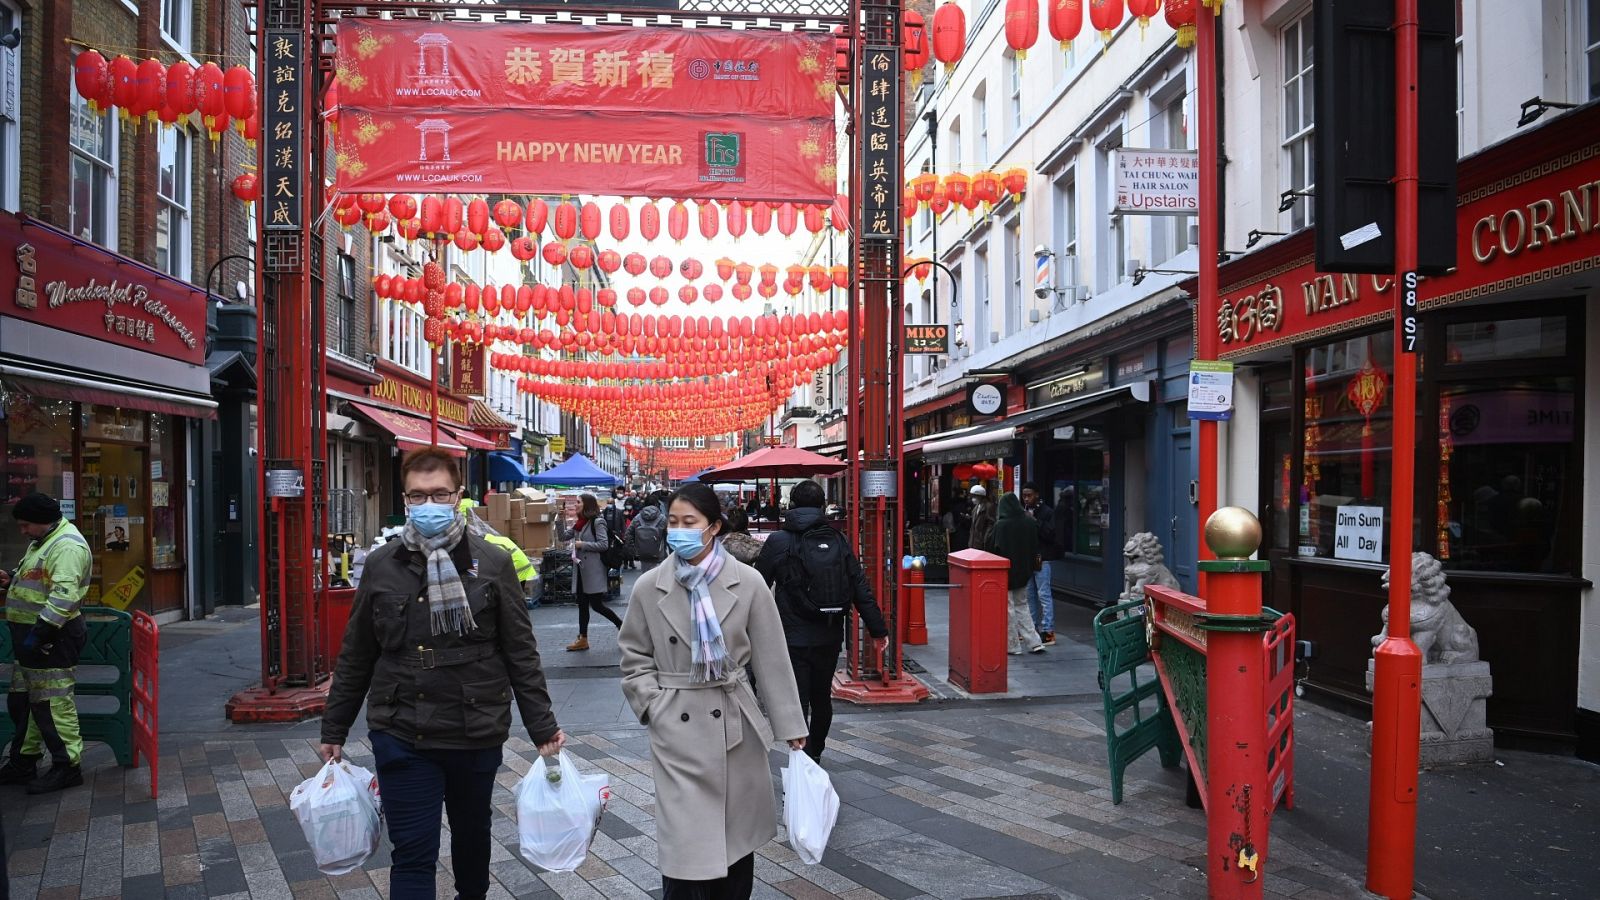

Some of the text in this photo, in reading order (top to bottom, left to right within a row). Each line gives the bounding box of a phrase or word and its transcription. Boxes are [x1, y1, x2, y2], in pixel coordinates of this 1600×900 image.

[504, 47, 675, 90] 恭賀新禧
[396, 88, 481, 97] WWW.LCCAUK.COM
[496, 141, 683, 164] HAPPY NEW YEAR
[396, 173, 483, 183] WWW.LCCAUK.COM
[1123, 171, 1139, 179] TAI
[1142, 171, 1174, 179] CHUNG
[1133, 182, 1189, 190] HAIR SALON
[1131, 193, 1196, 209] Upstairs
[1472, 180, 1600, 263] CORN
[16, 243, 38, 308] 名品
[45, 278, 132, 310] Wonderful
[1301, 274, 1359, 316] WAN
[906, 326, 946, 338] MIKO
[374, 378, 398, 401] LOON
[401, 383, 422, 409] FUNG
[1337, 512, 1381, 528] Dim Sum
[1336, 535, 1377, 553] All Day
